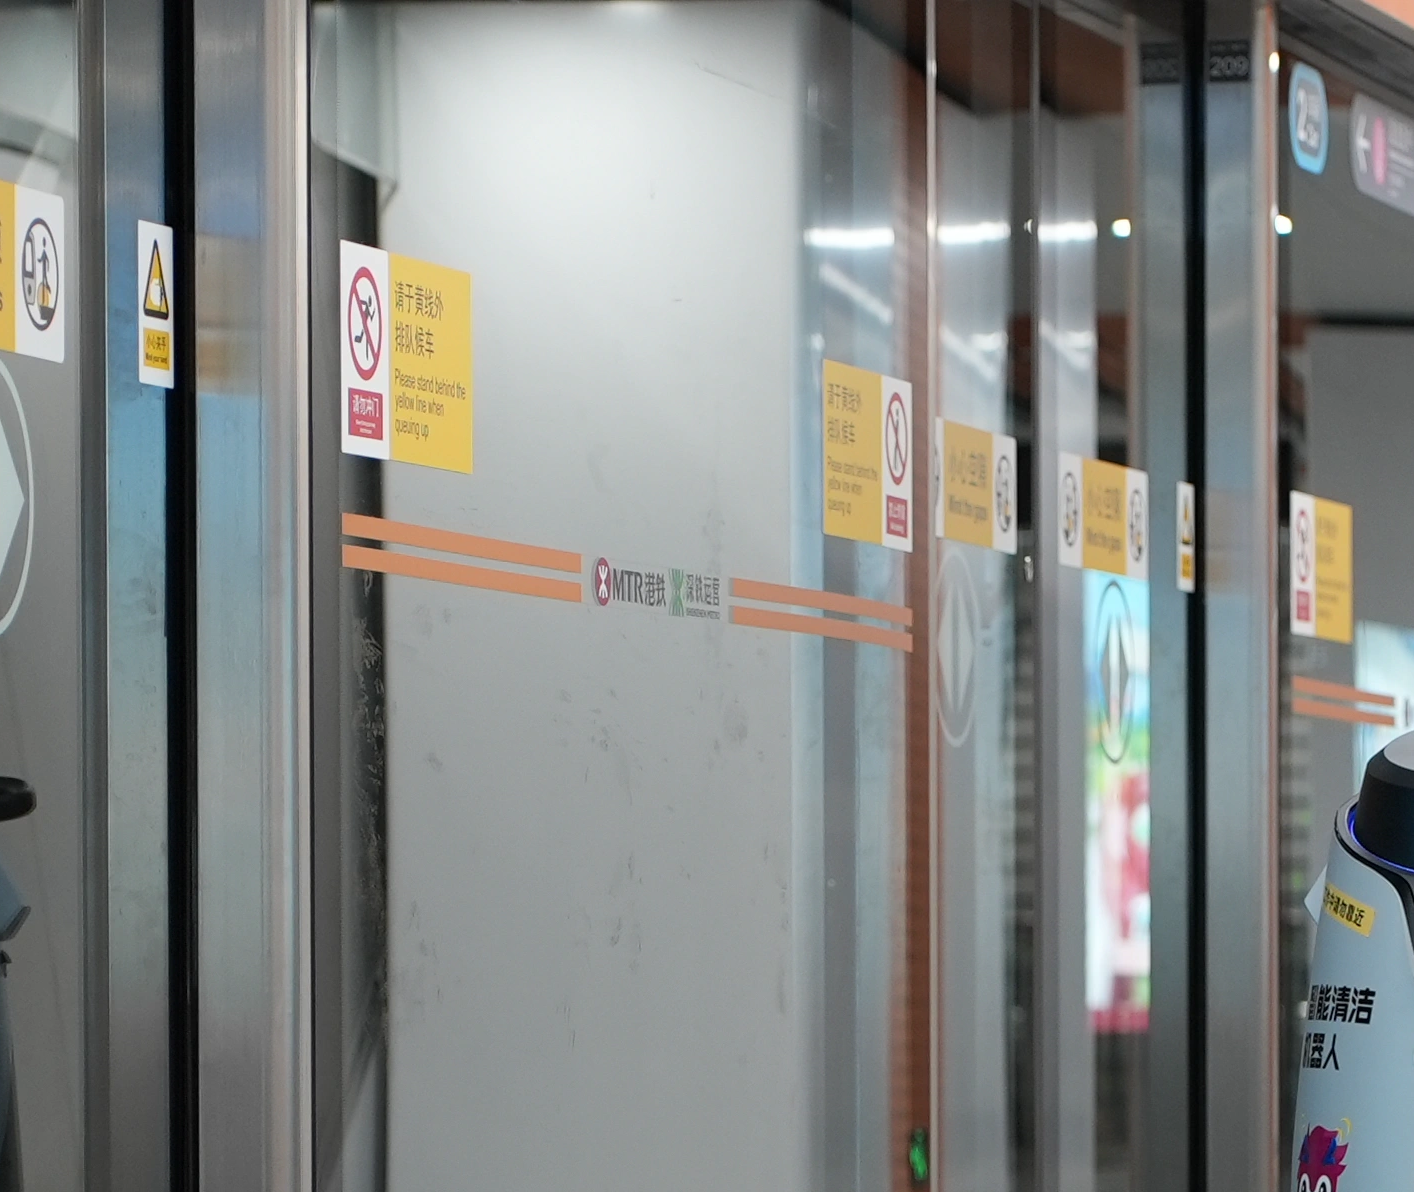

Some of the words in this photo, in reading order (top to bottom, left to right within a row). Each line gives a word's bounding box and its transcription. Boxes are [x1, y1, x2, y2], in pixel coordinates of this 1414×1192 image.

[394, 280, 444, 321] 请于黄线外
[394, 321, 435, 360] 排队候车
[394, 368, 415, 390] Please
[417, 375, 434, 394] stand
[435, 377, 455, 398] behind
[456, 382, 466, 400] the
[394, 392, 415, 412] yellow
[415, 395, 427, 414] line
[428, 398, 445, 417] when
[394, 418, 420, 440] queuing
[420, 424, 429, 442] up
[612, 568, 644, 605] MTR
[644, 571, 667, 607] 港铁
[685, 573, 720, 606] 深铁运营
